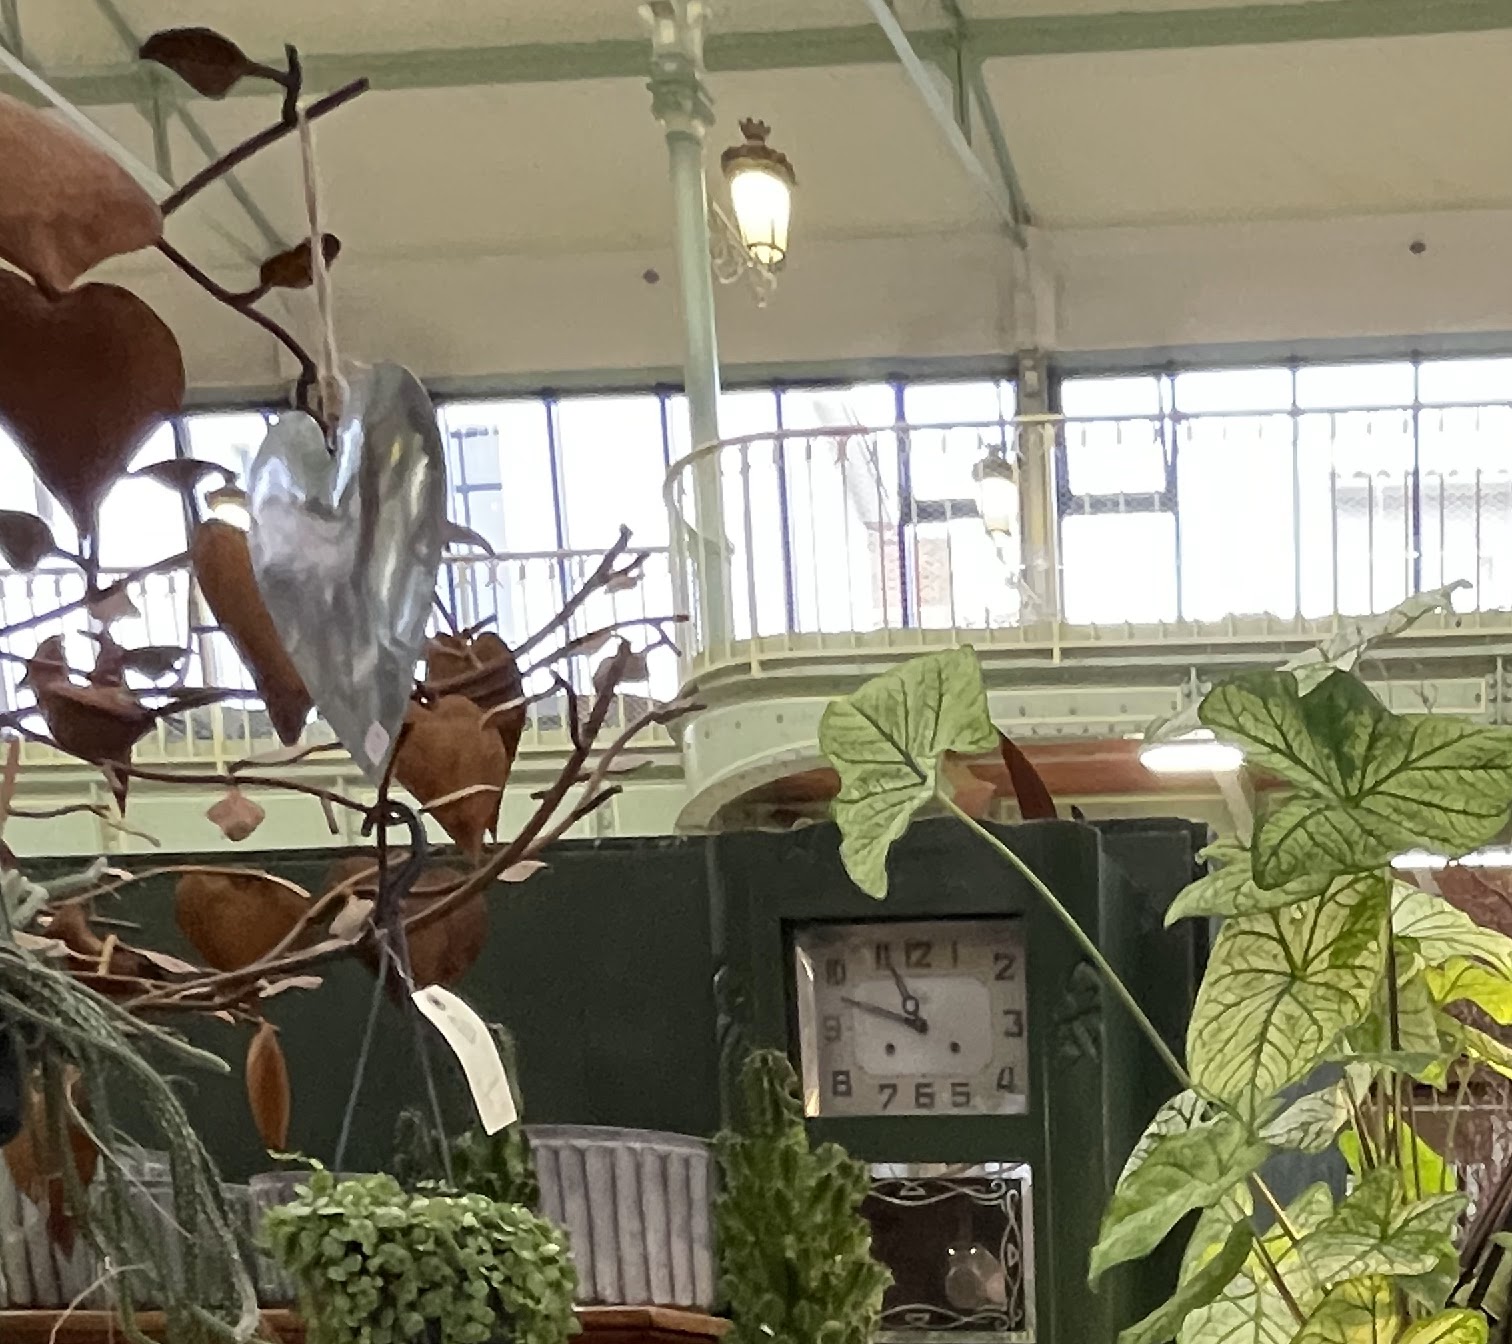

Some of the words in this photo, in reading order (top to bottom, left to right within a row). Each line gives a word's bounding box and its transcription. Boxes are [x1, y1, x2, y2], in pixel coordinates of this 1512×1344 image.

[904, 940, 932, 968] 12
[951, 940, 959, 968] 1
[994, 952, 1016, 981] 2
[825, 958, 846, 985] 10
[823, 1015, 842, 1042] 9
[1003, 1008, 1024, 1037] 3
[832, 1070, 852, 1097] 8
[996, 1066, 1015, 1092] 4
[878, 1082, 898, 1110] 7
[914, 1082, 935, 1109] 6
[950, 1082, 970, 1108] 5
